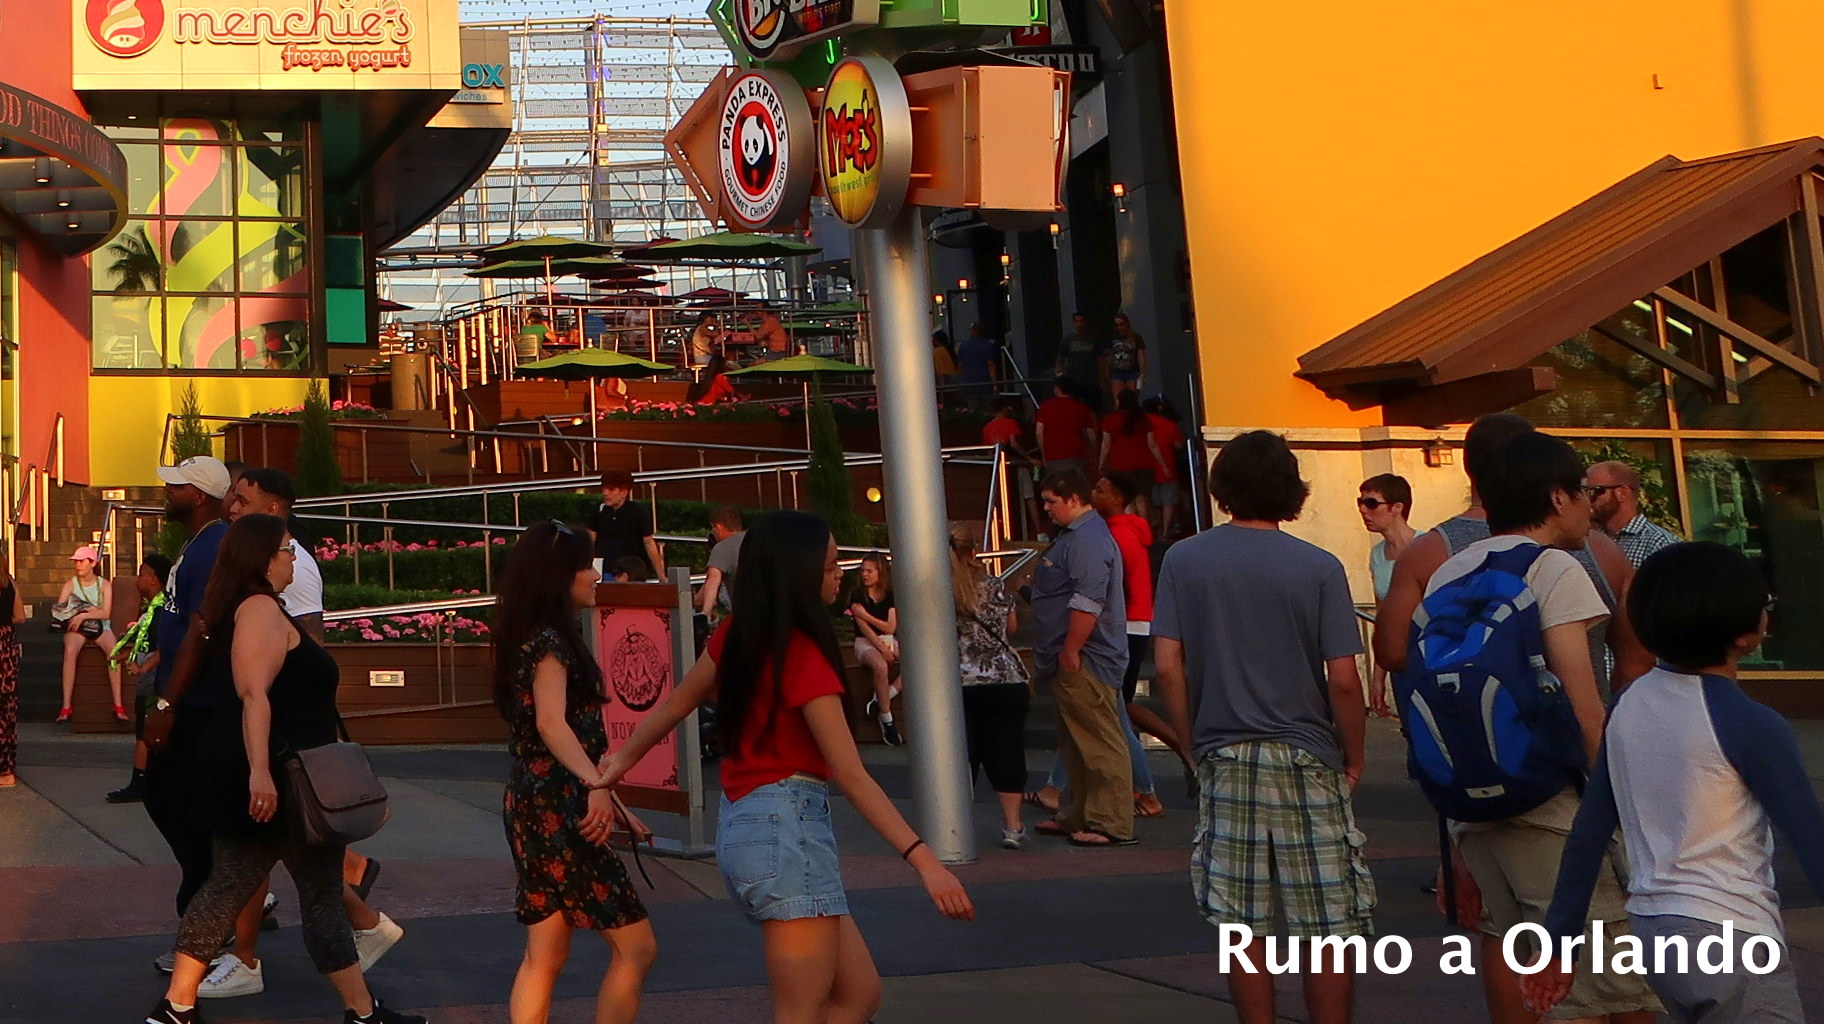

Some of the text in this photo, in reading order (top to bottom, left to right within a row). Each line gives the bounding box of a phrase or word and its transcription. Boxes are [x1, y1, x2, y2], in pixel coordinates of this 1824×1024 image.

[283, 43, 412, 71] frozen yogurt
[27, 99, 82, 155] THINGS
[722, 80, 787, 150] PANDA EXPRESS
[724, 160, 787, 218] GOURMET CHINESE FOOD
